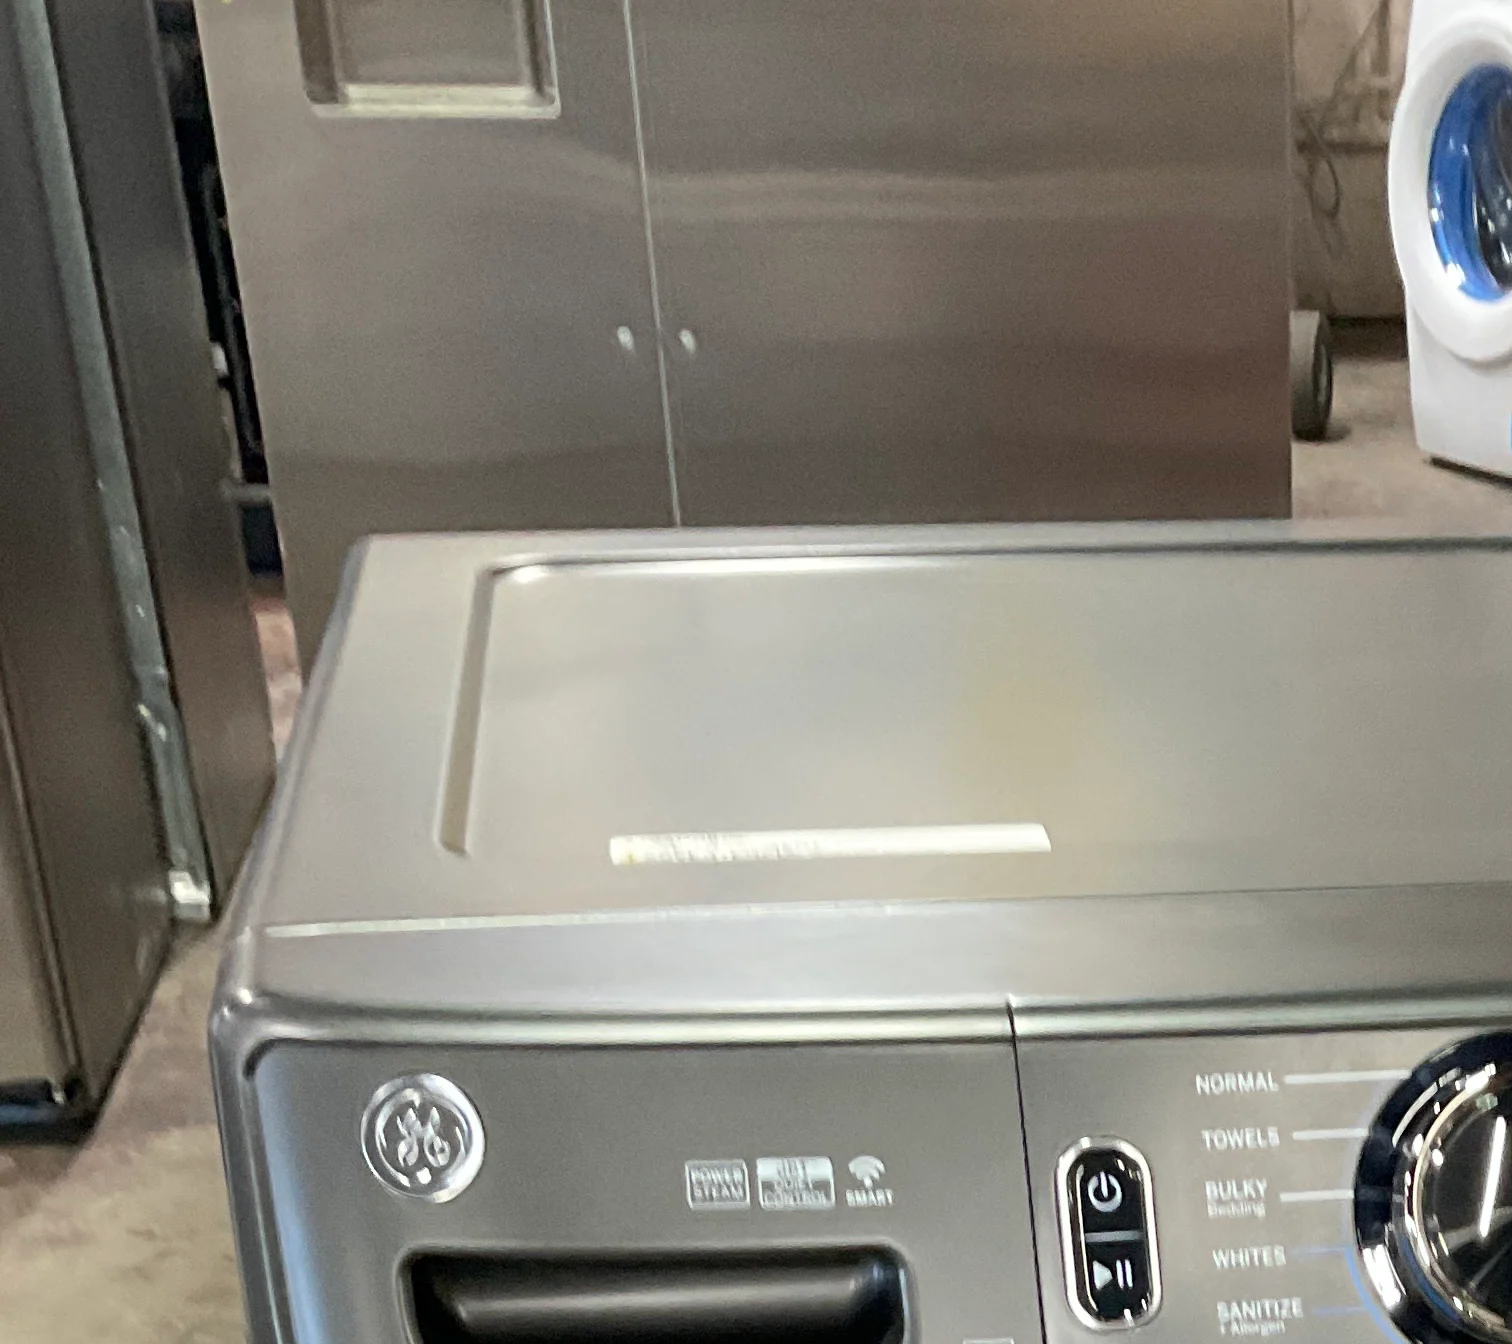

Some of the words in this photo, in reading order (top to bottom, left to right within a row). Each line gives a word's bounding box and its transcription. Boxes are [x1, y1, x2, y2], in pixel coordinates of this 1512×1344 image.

[1195, 1071, 1279, 1095] NORMAL
[1202, 1127, 1280, 1151] TOWELS
[846, 1188, 893, 1207] SMART
[1205, 1178, 1267, 1201] BULKY
[1212, 1245, 1286, 1270] WHITES
[1217, 1297, 1304, 1323] SANITIZE
